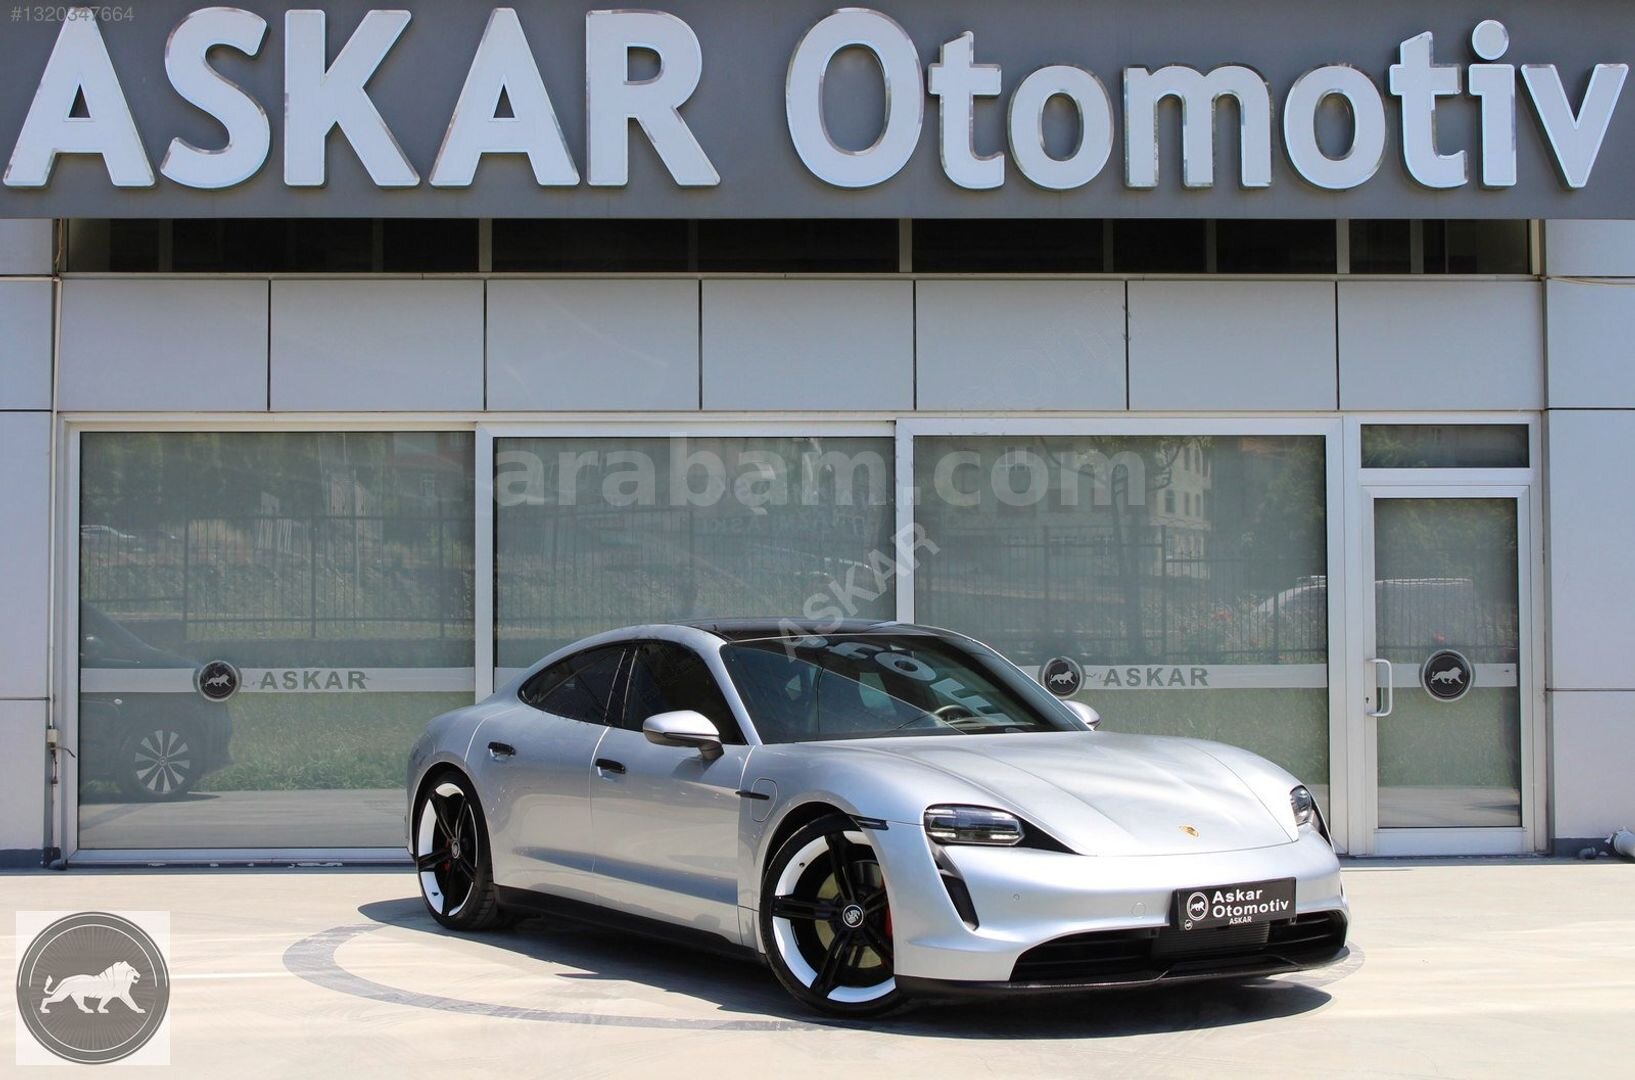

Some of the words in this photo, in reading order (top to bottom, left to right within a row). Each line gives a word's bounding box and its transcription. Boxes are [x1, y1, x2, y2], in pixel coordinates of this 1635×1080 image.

[3, 8, 721, 188] ASKAR
[785, 8, 1629, 190] Otomotiv
[259, 670, 367, 690] ASKAR
[1103, 667, 1209, 687] ASKAR
[1212, 889, 1263, 904] Askar
[1212, 899, 1289, 918] Otomotiv
[1229, 916, 1252, 925] ASKAR
